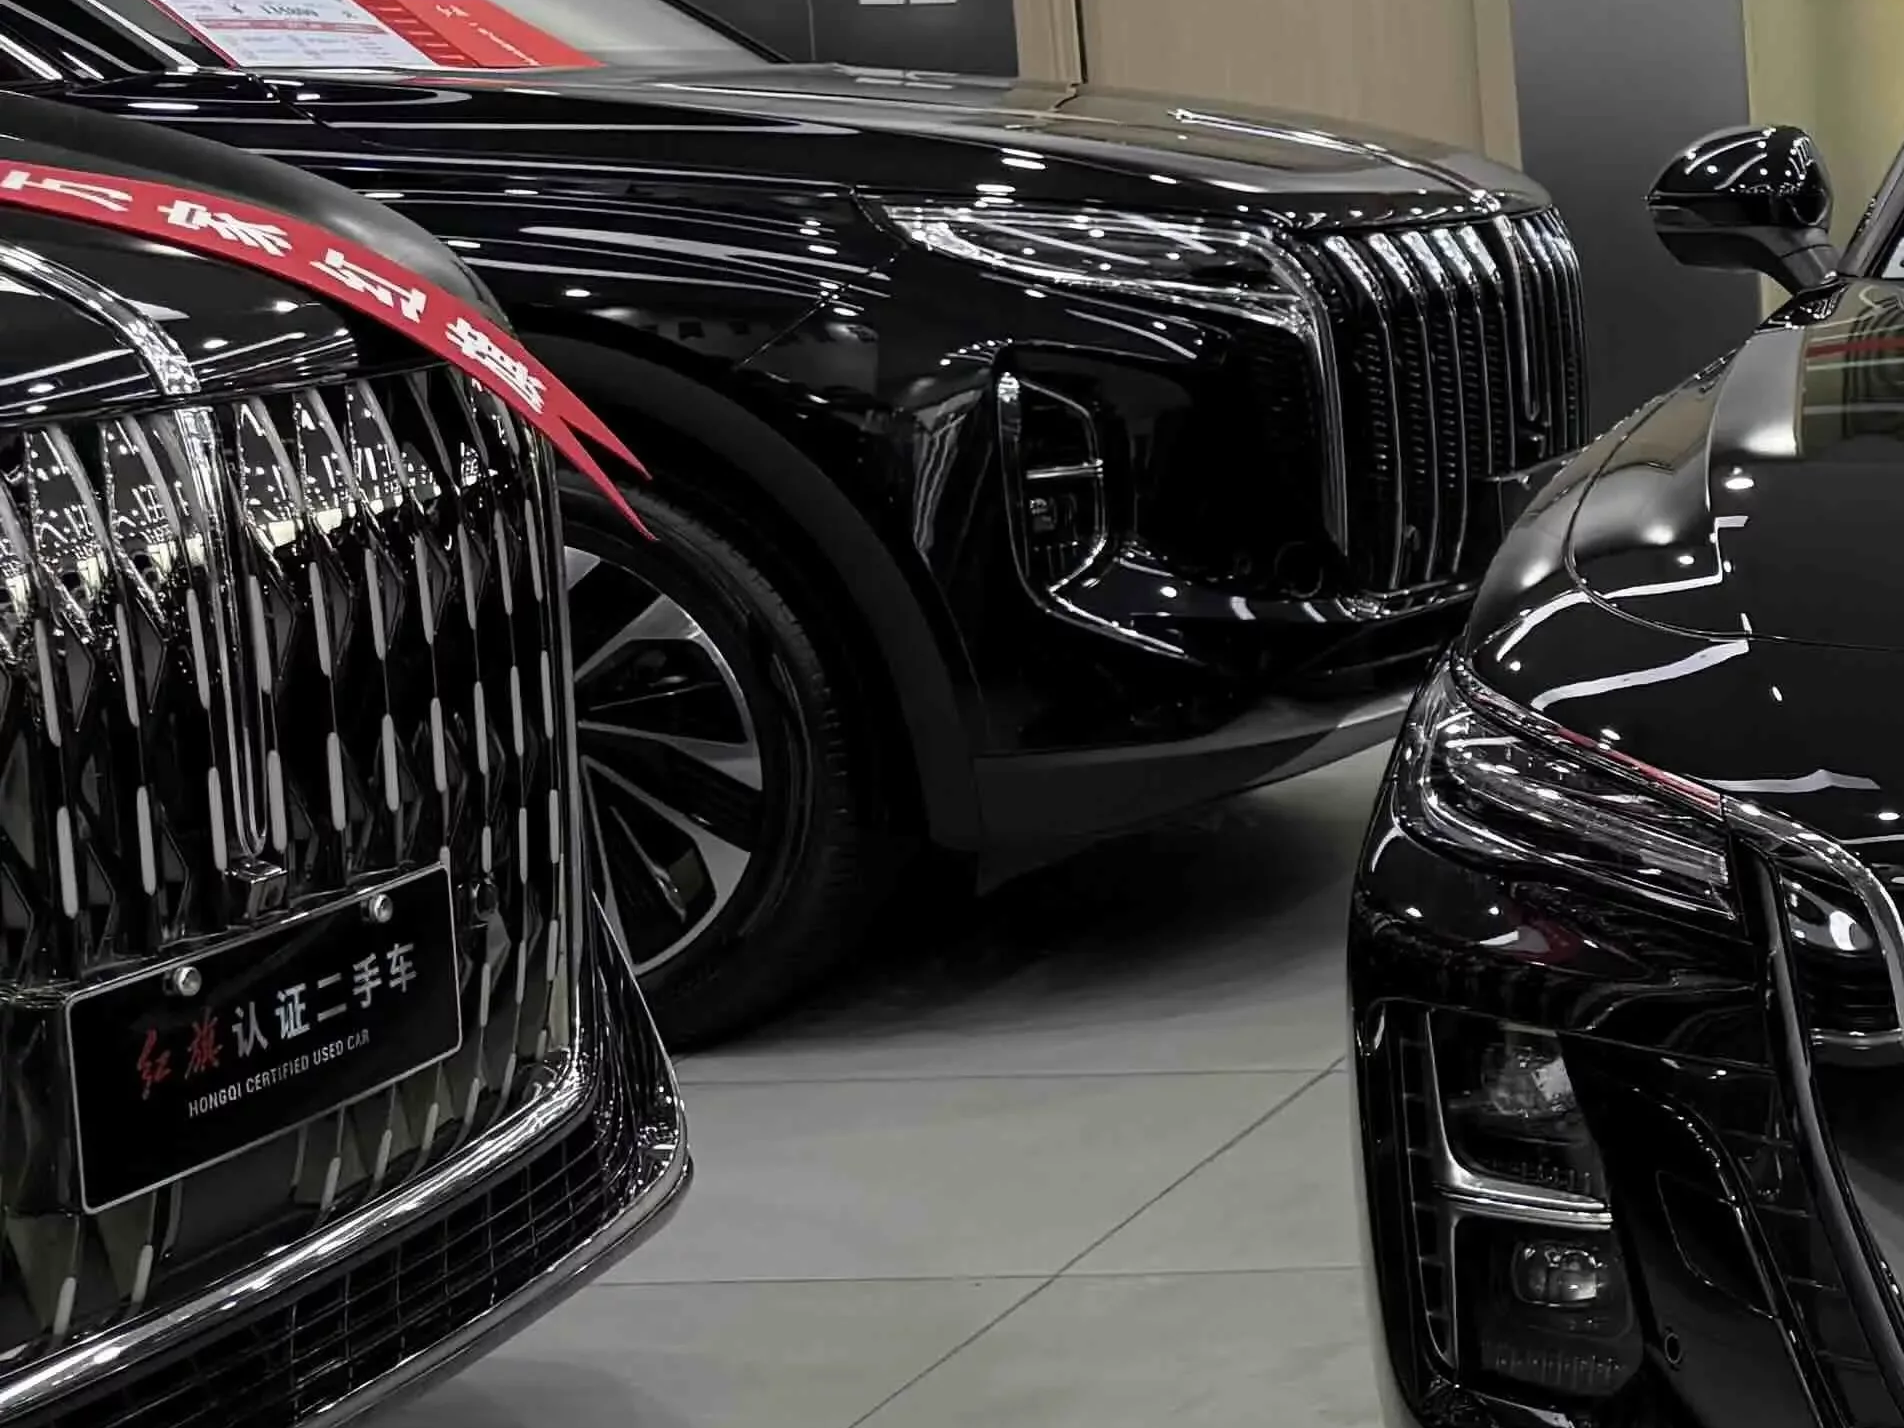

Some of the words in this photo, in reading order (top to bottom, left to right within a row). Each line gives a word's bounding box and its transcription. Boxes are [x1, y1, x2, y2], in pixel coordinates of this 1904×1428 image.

[188, 1082, 242, 1118] HONGQI
[246, 1054, 309, 1094] CERTIFIED
[312, 1039, 344, 1066] USED
[347, 1028, 371, 1051] CAR
